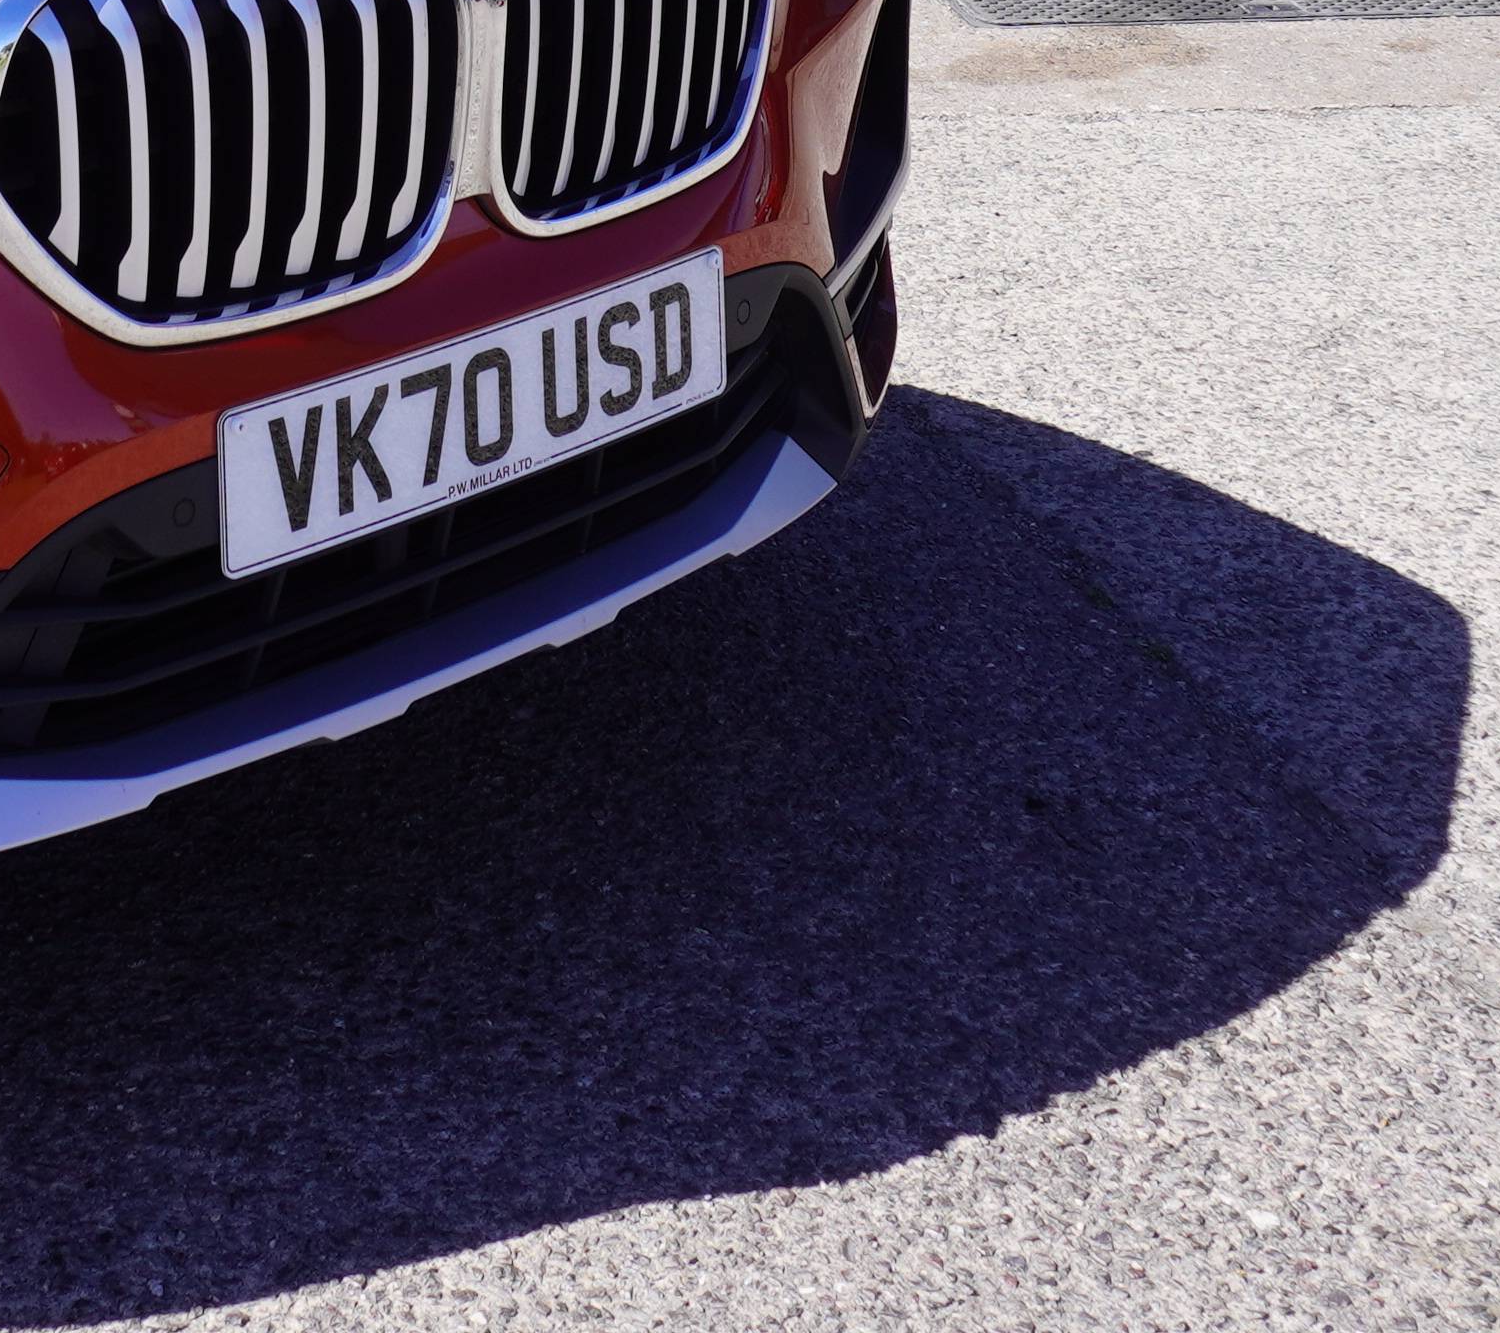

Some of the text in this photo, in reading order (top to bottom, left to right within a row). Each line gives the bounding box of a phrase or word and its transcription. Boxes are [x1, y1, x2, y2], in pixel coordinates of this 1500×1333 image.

[267, 280, 695, 533] VK70 USD
[447, 466, 511, 499] P.W.MILLAR
[512, 456, 533, 475] LTD
